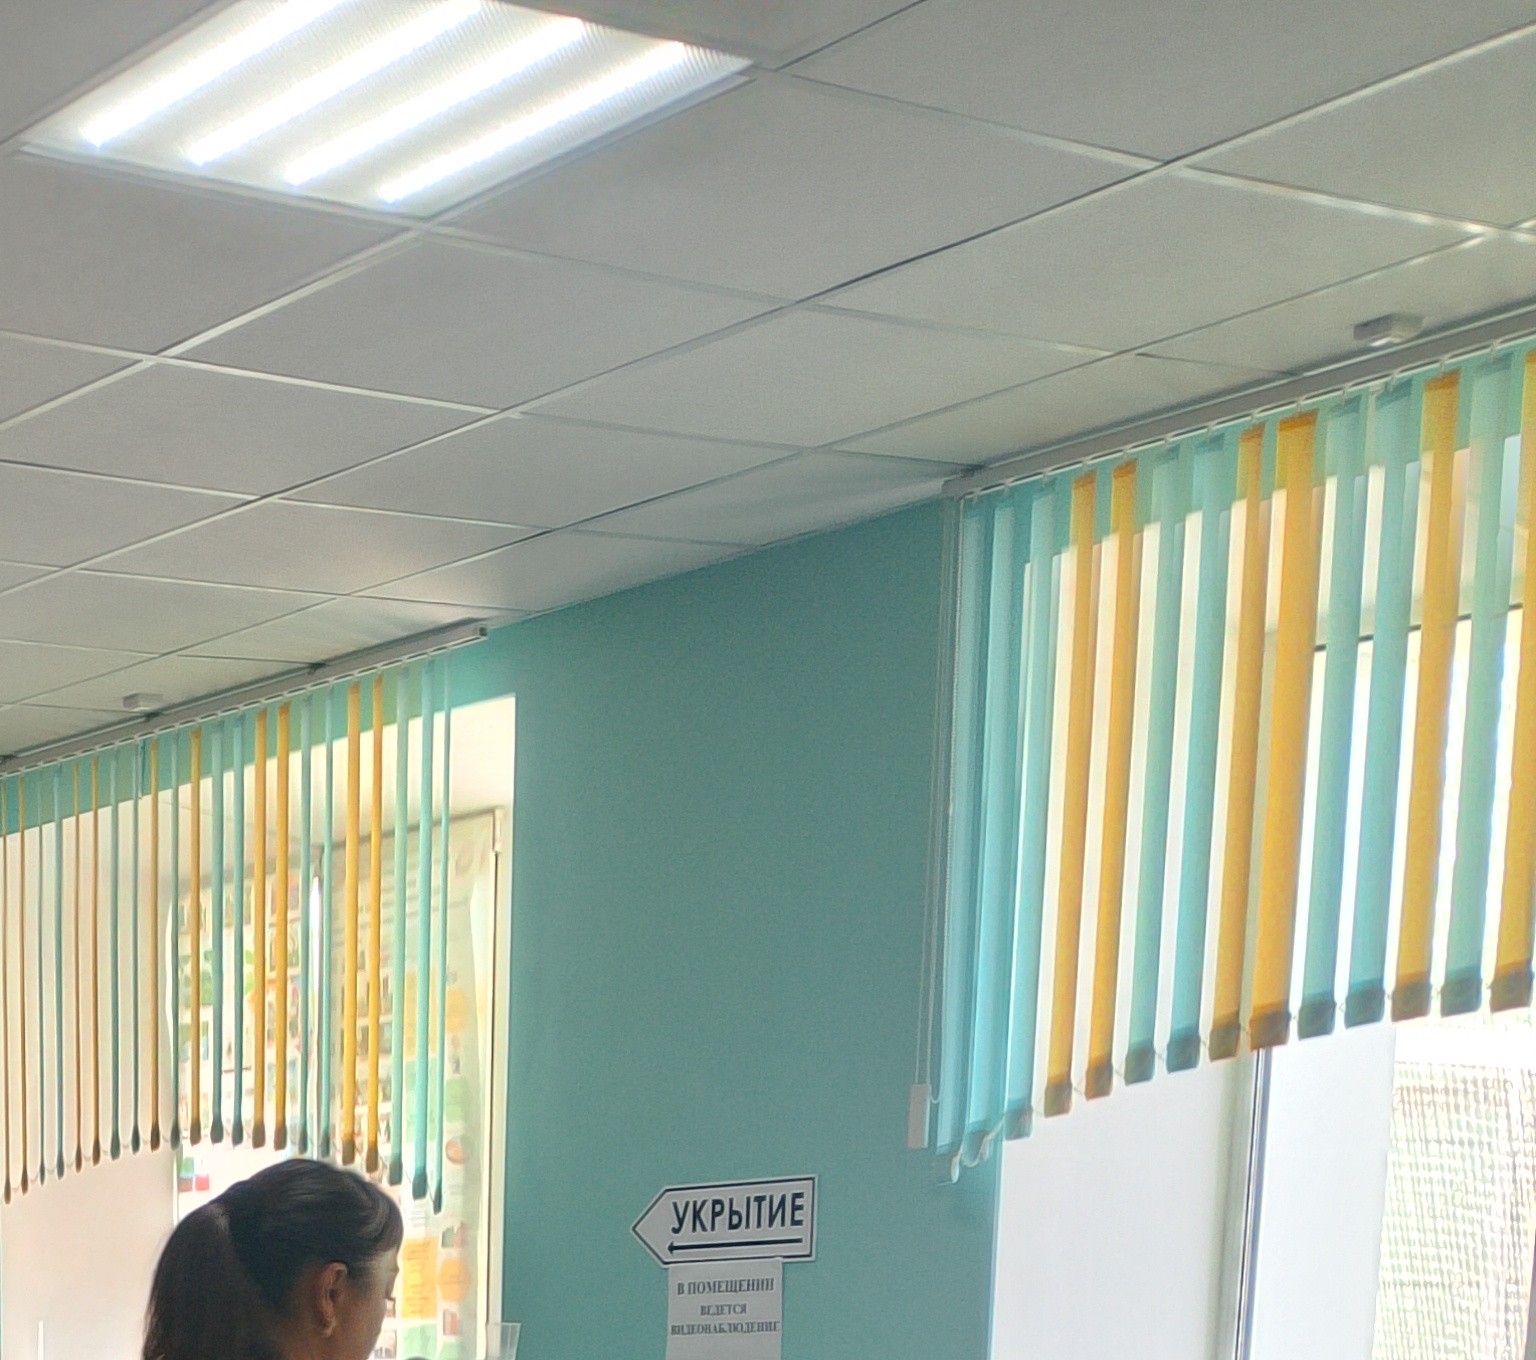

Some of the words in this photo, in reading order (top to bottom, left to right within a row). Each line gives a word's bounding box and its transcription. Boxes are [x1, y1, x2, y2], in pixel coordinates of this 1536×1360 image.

[671, 1191, 805, 1235] УКРЫТИЕ
[677, 1281, 685, 1295] В
[687, 1277, 775, 1296] ПОМЕЩЕНИИ
[700, 1303, 747, 1316] ВЕДЕТСЯ
[671, 1320, 780, 1336] ВИДЕОНАБЛЮДЕНИЕ
